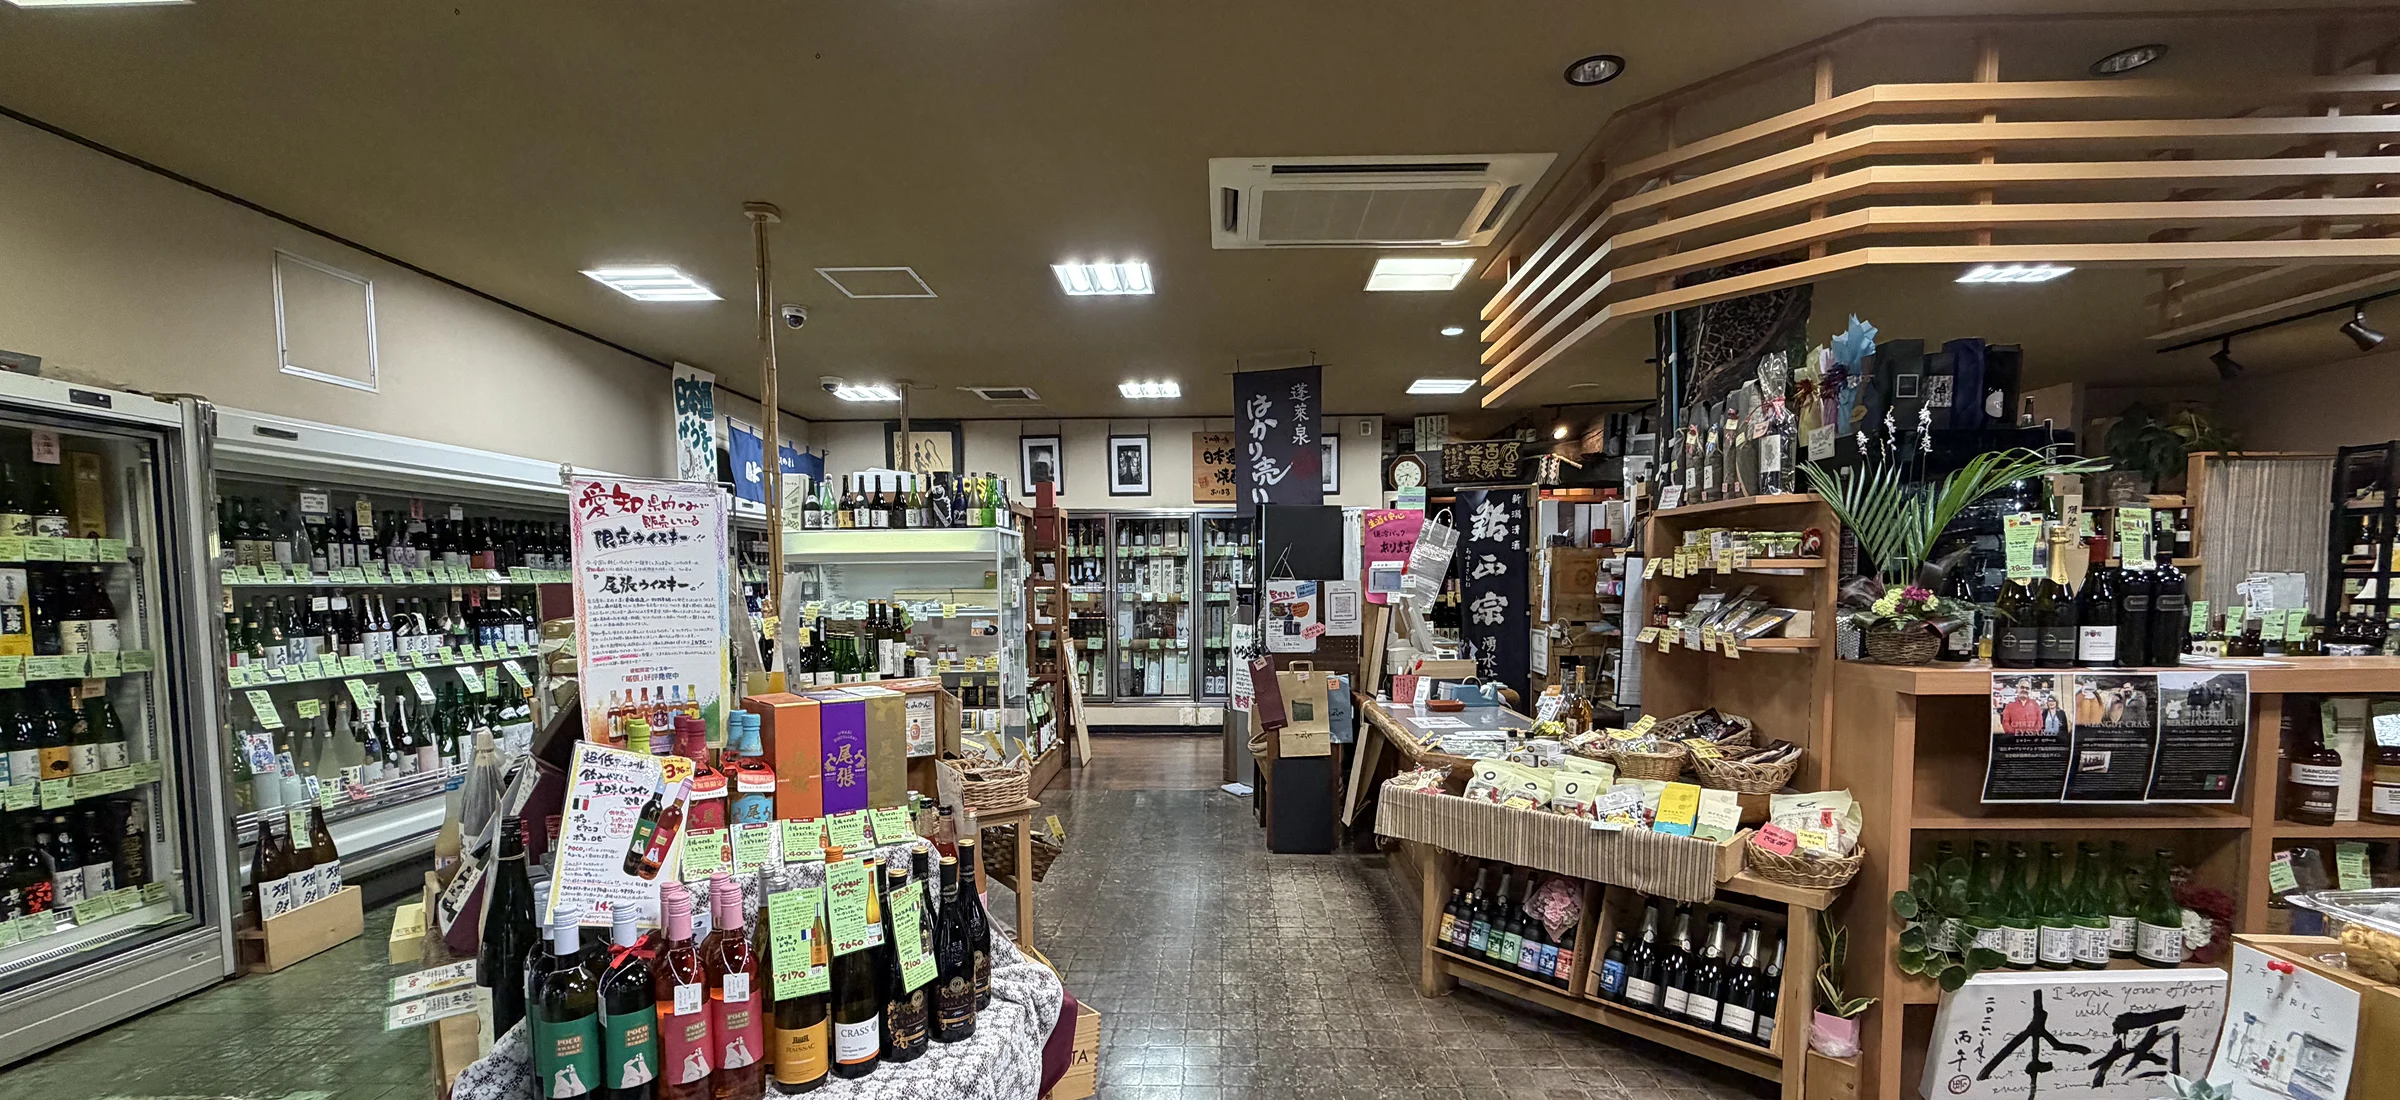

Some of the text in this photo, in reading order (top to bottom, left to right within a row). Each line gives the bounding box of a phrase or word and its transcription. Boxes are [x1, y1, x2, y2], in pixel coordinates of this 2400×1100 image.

[642, 514, 700, 529] 販売している
[1511, 494, 1522, 551] 新潟清酒
[1380, 541, 1413, 554] あります
[1469, 499, 1510, 626] 鮎正宗
[621, 672, 680, 683] 「尾張」好評発売中
[2125, 720, 2150, 728] CRASS
[835, 743, 856, 788] 尾張
[904, 959, 921, 970] 2100
[780, 971, 806, 982] 2170
[2266, 987, 2322, 1020] PARIS
[728, 1011, 748, 1020] POCO
[2075, 1003, 2108, 1018] will
[627, 1025, 649, 1036] POCO
[687, 1021, 706, 1032] POCO
[841, 1026, 869, 1038] CRASS
[557, 1037, 581, 1046] POCO
